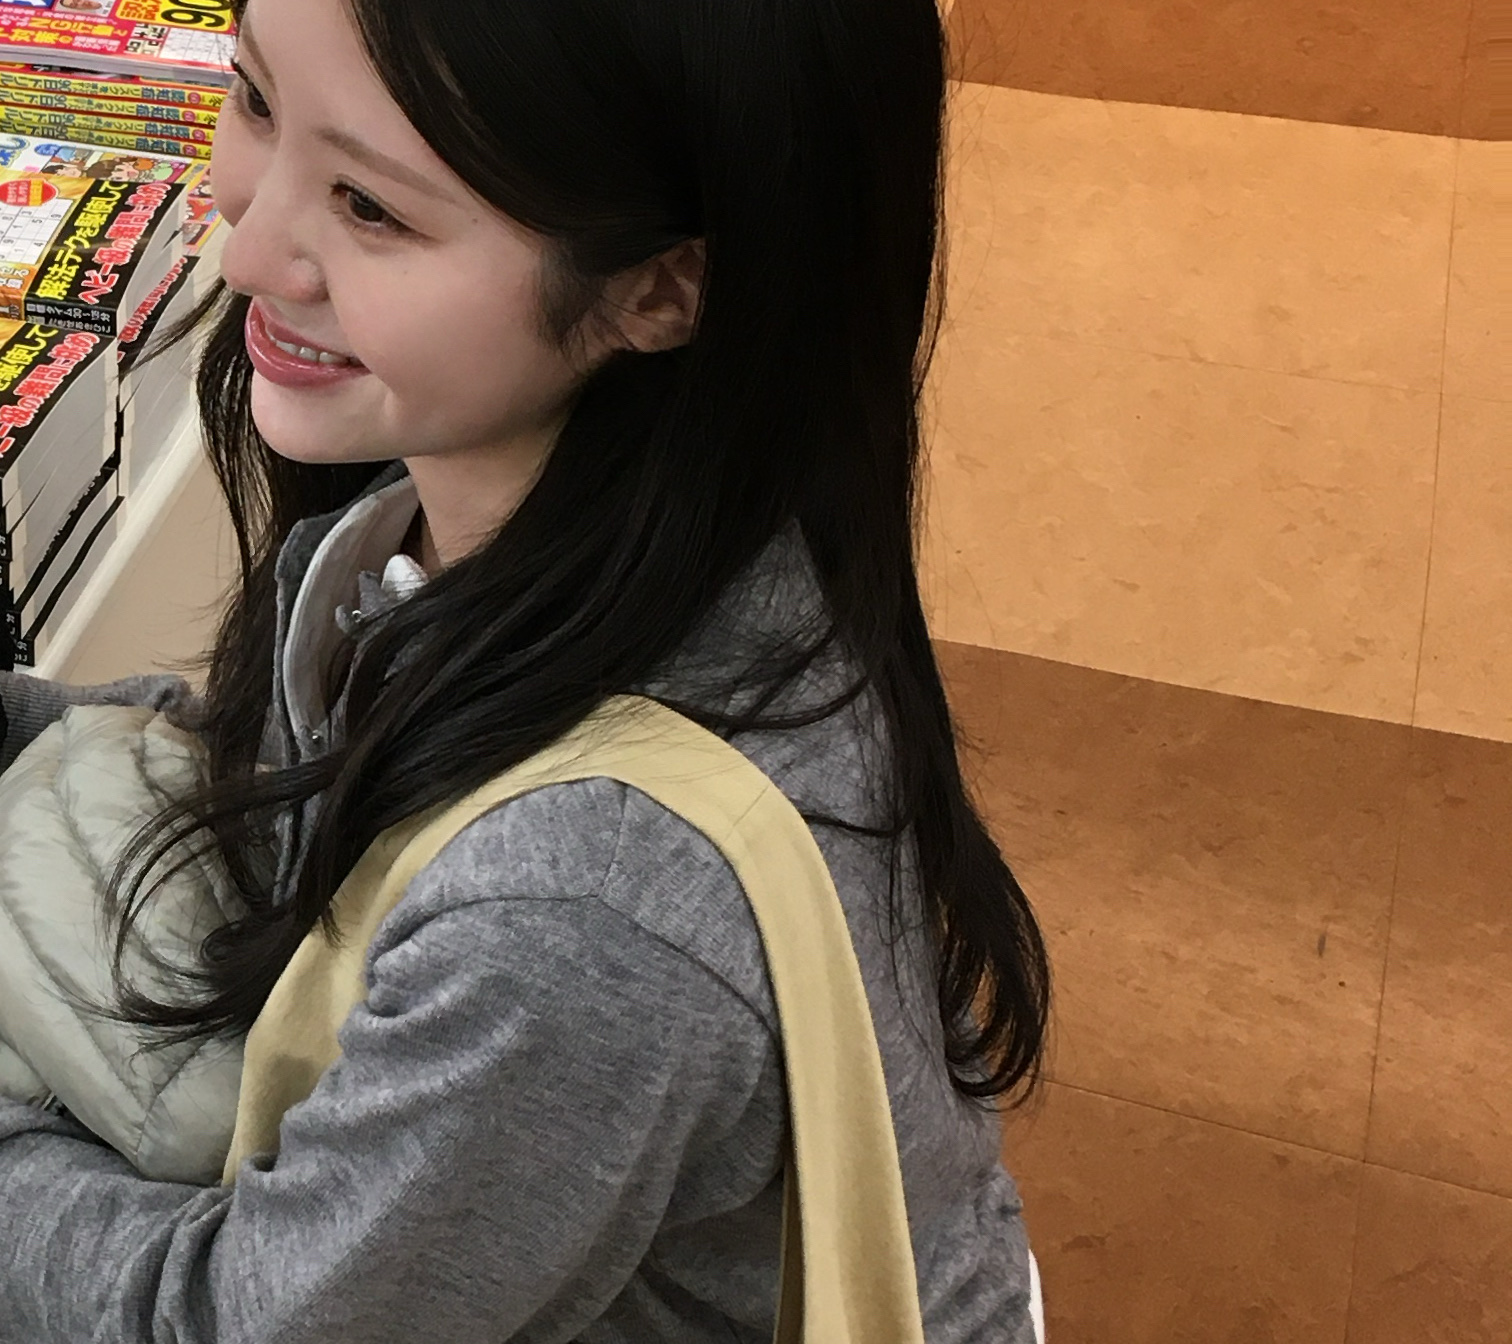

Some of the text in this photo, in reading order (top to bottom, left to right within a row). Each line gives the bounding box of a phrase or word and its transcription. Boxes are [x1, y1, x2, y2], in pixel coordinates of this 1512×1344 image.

[35, 180, 130, 302] 解法テクを駆使して
